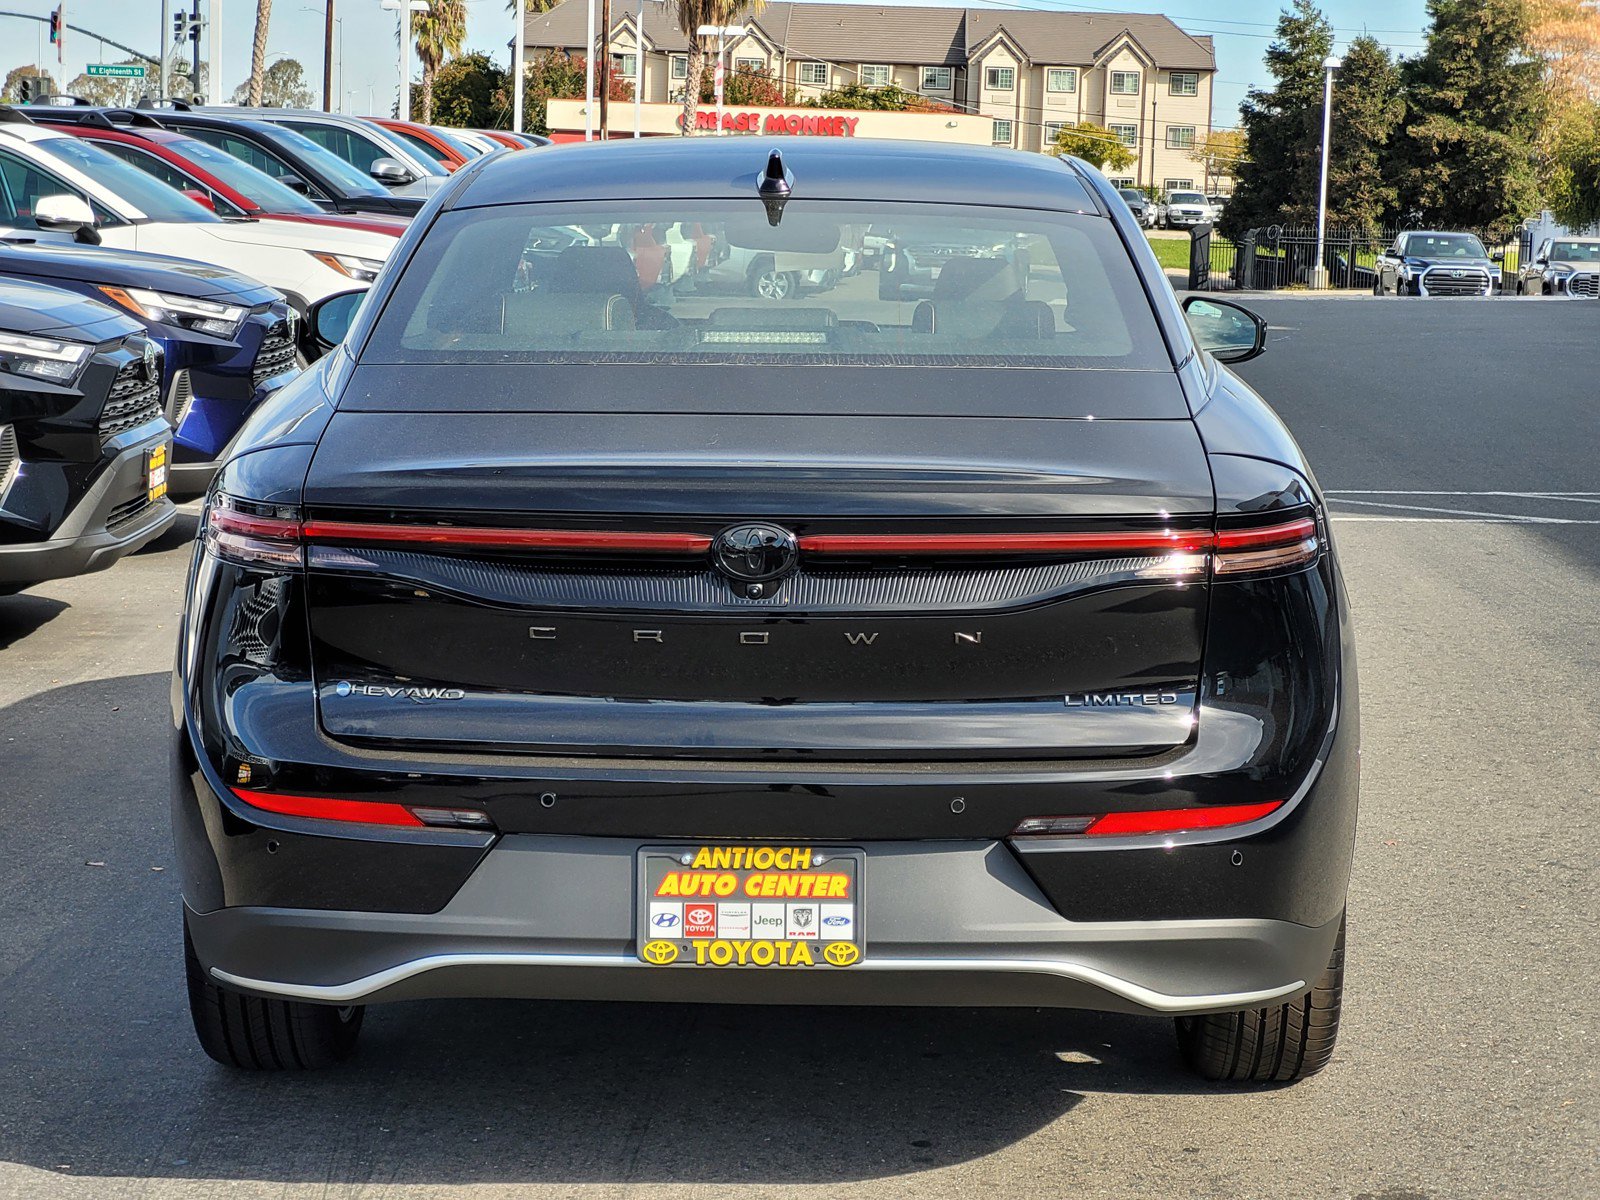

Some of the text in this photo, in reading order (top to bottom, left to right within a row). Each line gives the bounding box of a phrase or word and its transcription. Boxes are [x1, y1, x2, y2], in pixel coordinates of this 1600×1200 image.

[98, 67, 133, 76] Eighteenth
[679, 112, 860, 137] REASE MONKEY
[528, 625, 983, 645] CROWN
[1064, 692, 1178, 707] LIMITED
[691, 847, 812, 870] ANTIOCH
[654, 872, 851, 898] AUTO CENTER
[685, 924, 716, 933] TOYOTA
[754, 915, 783, 927] Jeep
[827, 916, 848, 927] Ford
[692, 940, 814, 966] TOYOTA
